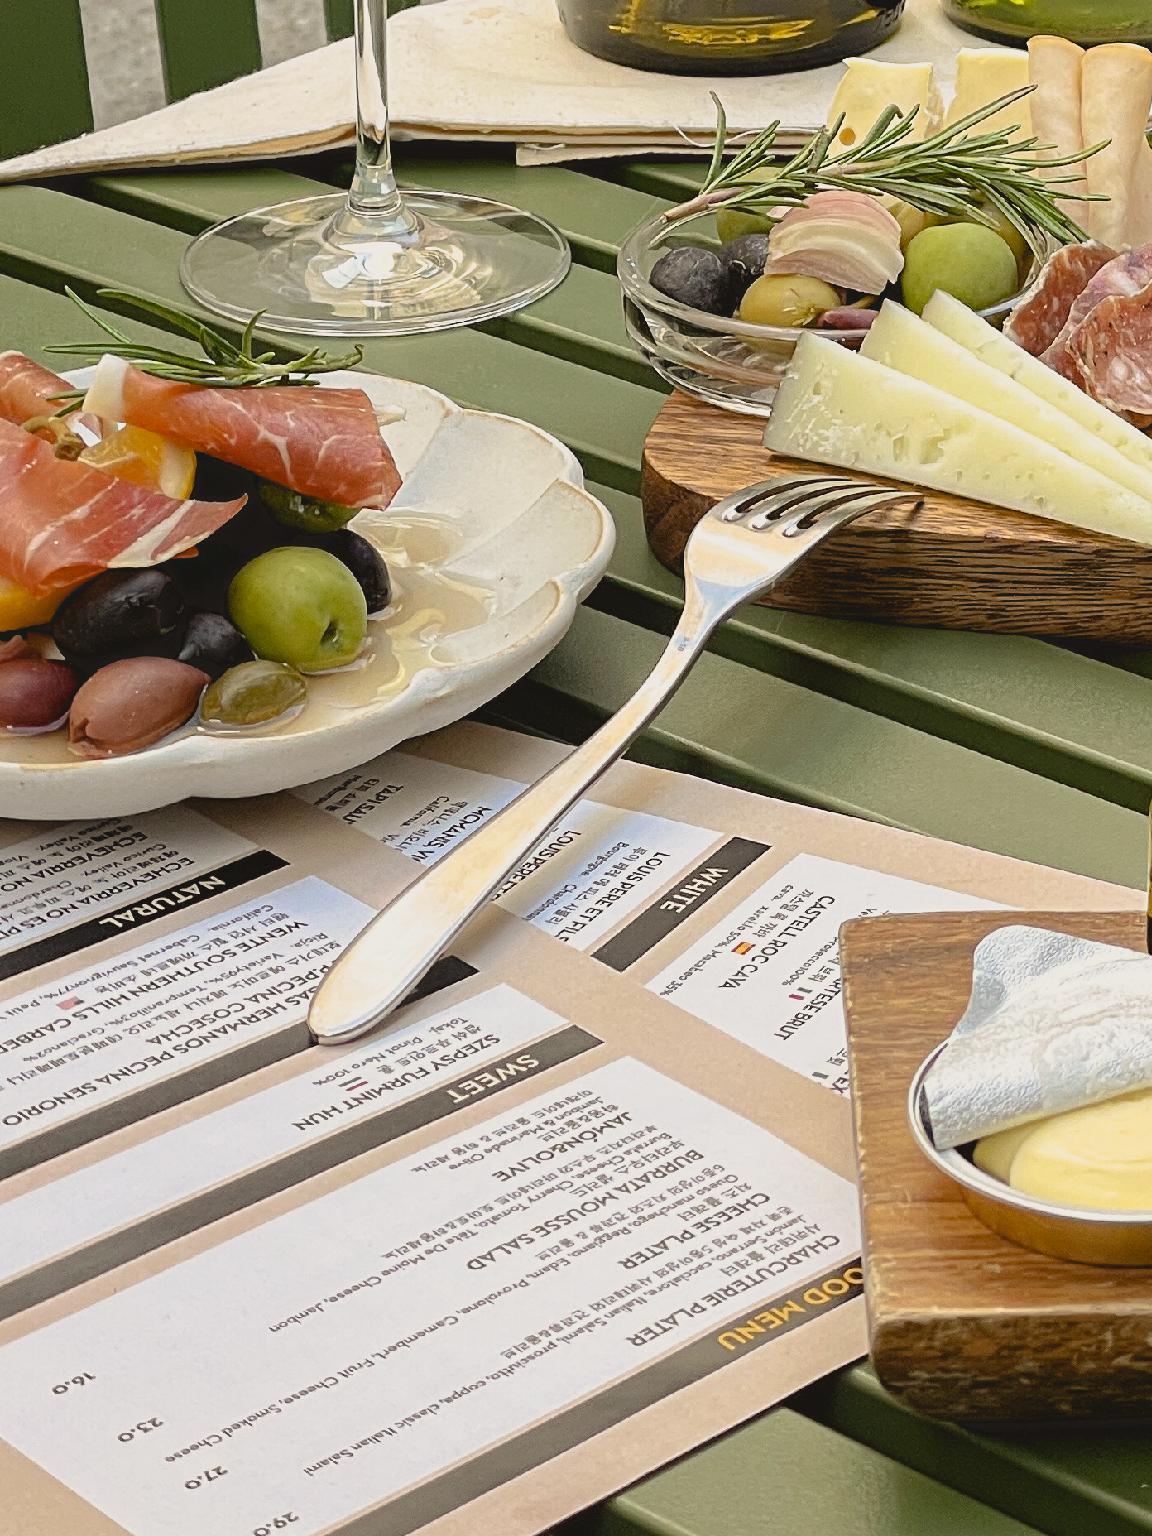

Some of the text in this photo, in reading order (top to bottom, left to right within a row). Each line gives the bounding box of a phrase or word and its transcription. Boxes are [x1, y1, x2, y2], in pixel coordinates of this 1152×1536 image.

[1, 830, 153, 891] ECHEVERRIA NO
[531, 831, 582, 861] LOUIS
[626, 852, 670, 881] LOUIS
[20, 857, 194, 928] ECHEVERRIA NO ES
[99, 876, 225, 927] NATURAL
[595, 882, 635, 907] PERE
[651, 868, 728, 913] WHITE
[580, 908, 603, 922] ET
[777, 896, 835, 943] CASTELL
[235, 922, 308, 952] WENTE
[751, 939, 787, 963] ROC
[128, 949, 237, 997] SOUTHERN
[660, 981, 683, 995] 35%
[718, 965, 758, 988] CAVA
[72, 994, 131, 1020] HILLS
[146, 1003, 245, 1044] COSECHA
[172, 1003, 287, 1053] HERMANOS
[774, 1013, 813, 1040] BRUT
[352, 1053, 386, 1069] Nero
[385, 1037, 423, 1054] Pinot
[95, 1051, 175, 1084] PECINA
[292, 1034, 500, 1130] SZEPSY FURMINT HUN
[312, 1069, 350, 1085] 100%
[446, 1055, 539, 1103] SWEET
[2, 1083, 97, 1125] SENORIO
[449, 1154, 484, 1169] Olive
[492, 1112, 632, 1182] JAMÓN&OLIVE
[467, 1150, 704, 1269] BURRATA MOUSSE SALAD
[618, 1193, 770, 1269] CHEESE PLATER
[626, 1236, 840, 1346] CHARCUTERIE PLATER
[717, 1267, 864, 1351] OOD MENU
[52, 1373, 96, 1394] 16.0
[118, 1418, 163, 1442] 23.0
[222, 1404, 281, 1437] Smoked
[166, 1435, 223, 1462] Cheese
[185, 1466, 228, 1489] 27.0
